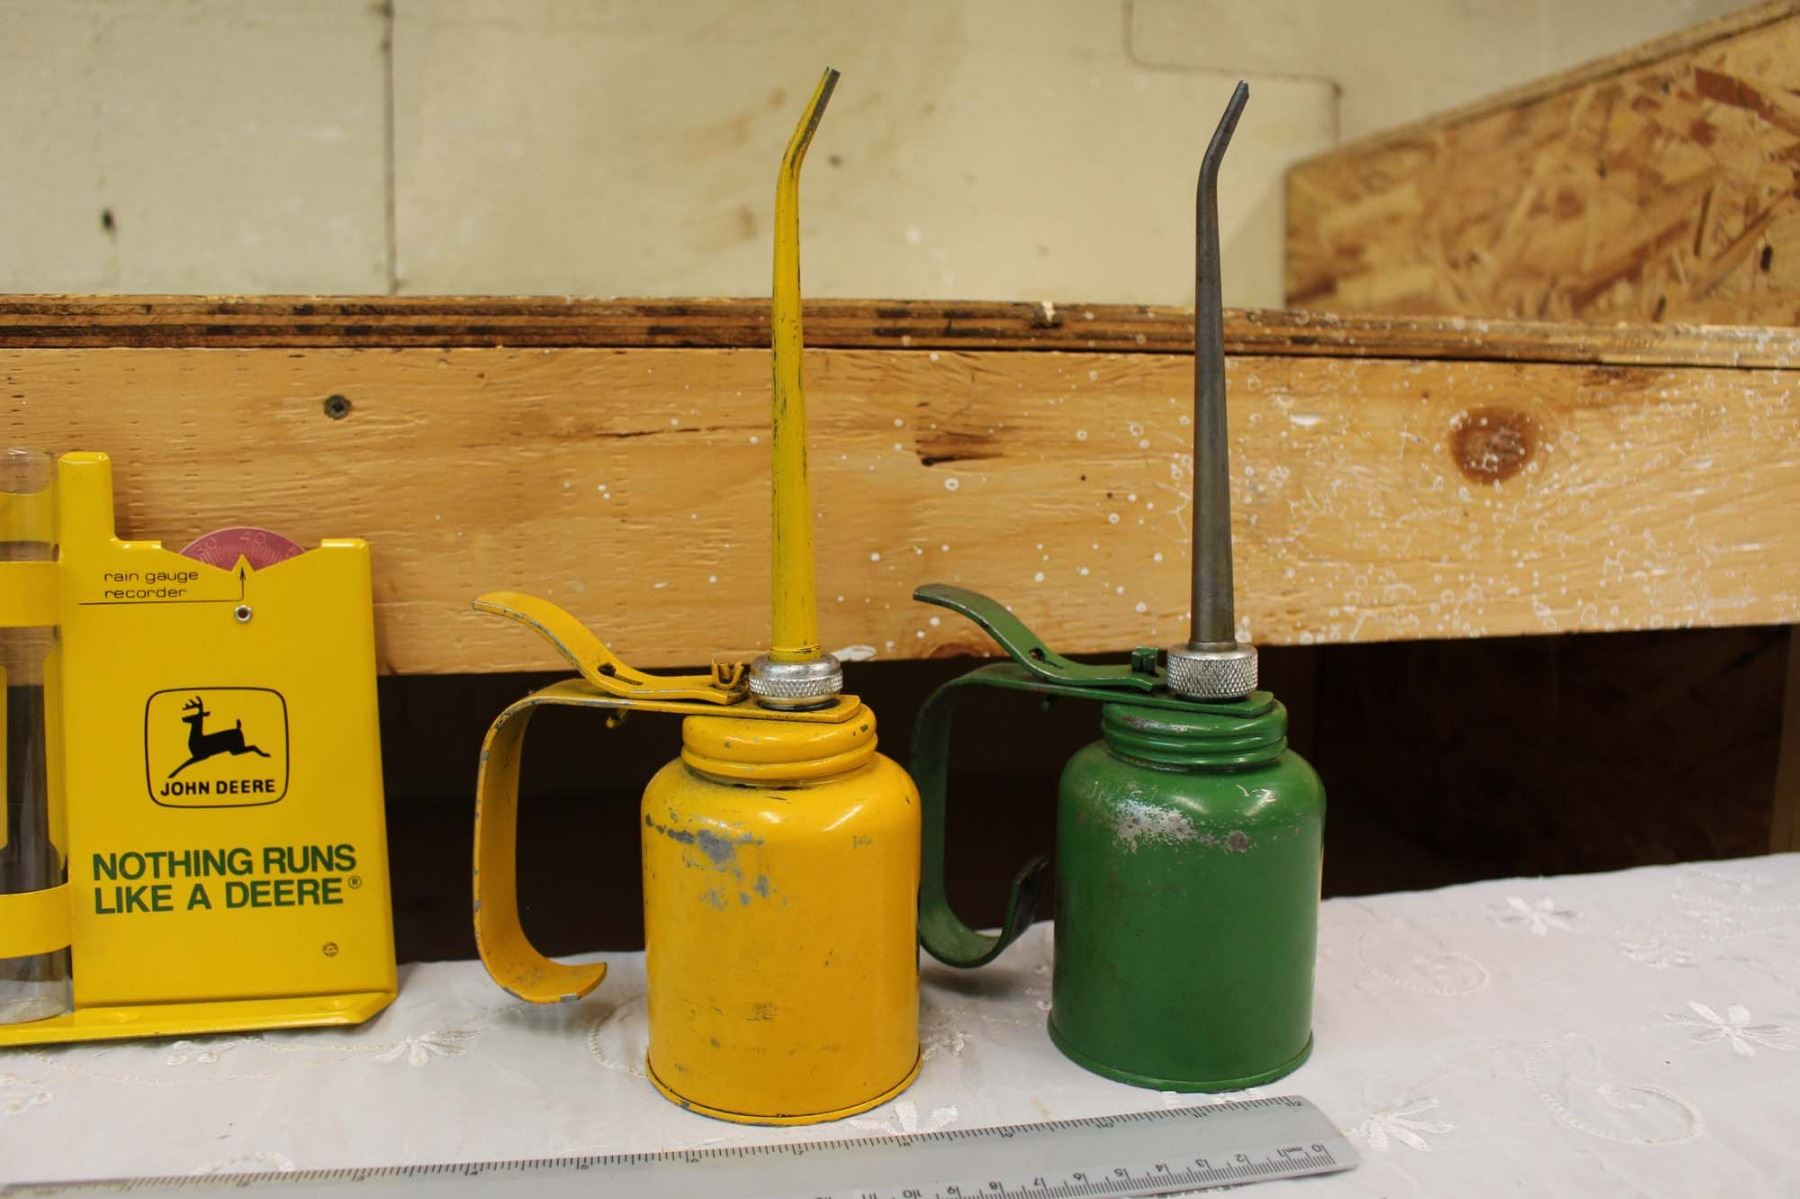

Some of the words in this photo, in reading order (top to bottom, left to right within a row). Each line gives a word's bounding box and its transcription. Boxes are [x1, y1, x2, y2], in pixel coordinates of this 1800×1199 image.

[104, 572, 140, 582] rain
[145, 571, 199, 584] gauge
[104, 588, 187, 599] recorder
[160, 781, 210, 796] JOHN
[216, 779, 276, 794] DEERE
[93, 848, 254, 881] NOTHING
[263, 844, 357, 874] RUNS
[94, 885, 174, 915] LIKE
[187, 883, 213, 911] A
[1195, 1158, 1206, 1168] 3
[1234, 1153, 1245, 1163] 2
[1113, 1167, 1124, 1178] 5
[1154, 1163, 1164, 1173] 4
[1033, 1176, 1042, 1187] 7
[1073, 1171, 1083, 1181] 6
[946, 1185, 957, 1195] 9
